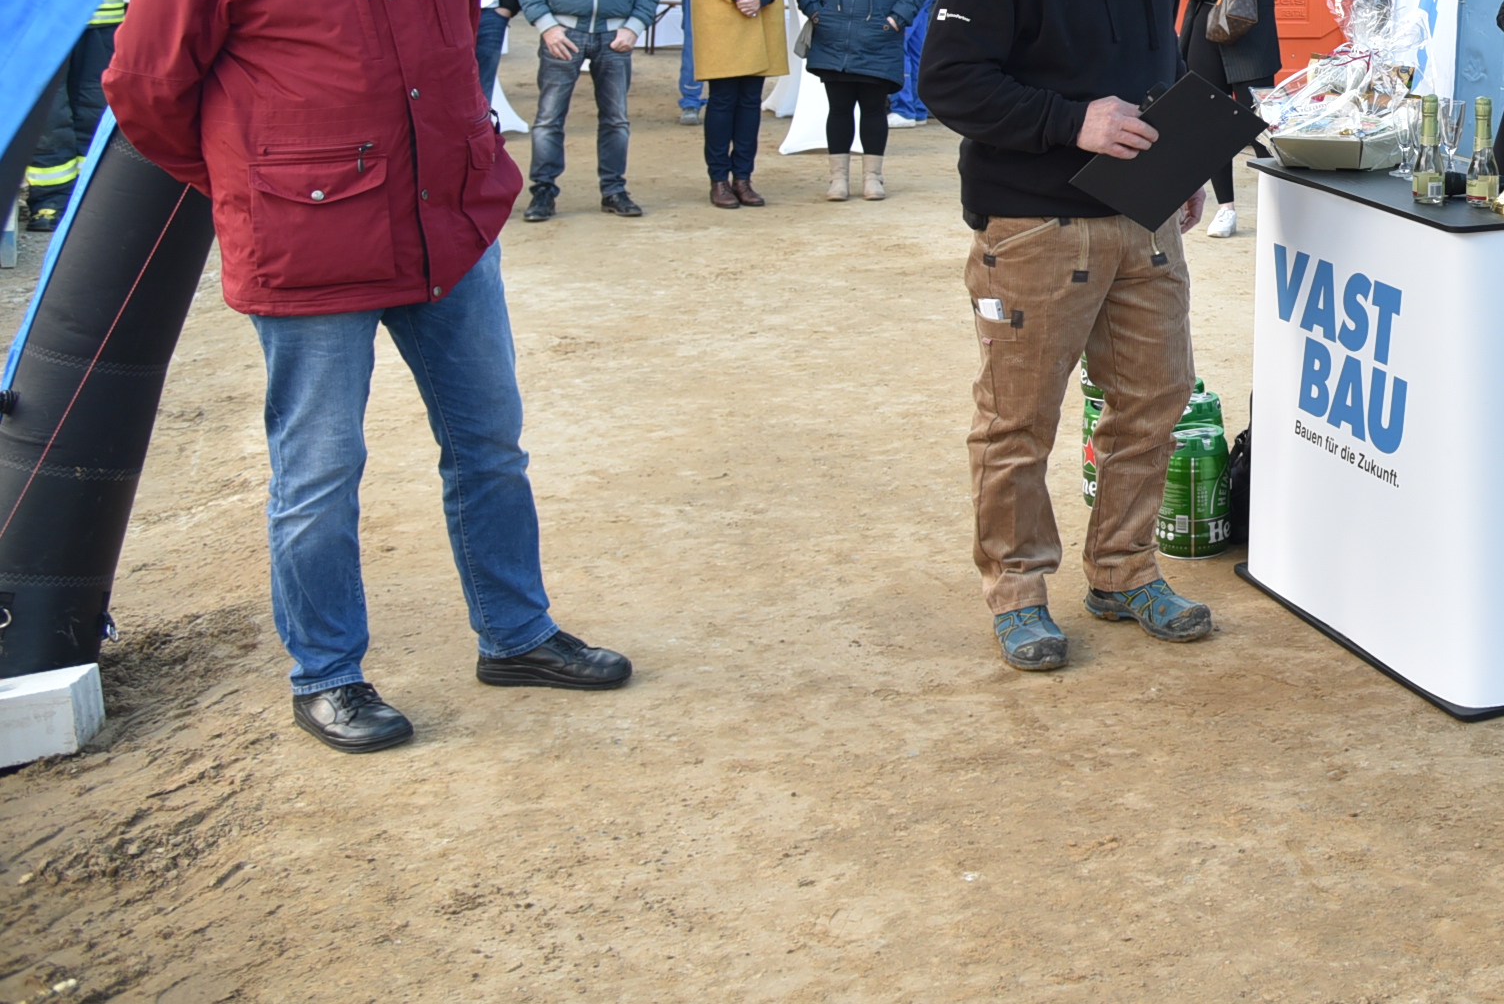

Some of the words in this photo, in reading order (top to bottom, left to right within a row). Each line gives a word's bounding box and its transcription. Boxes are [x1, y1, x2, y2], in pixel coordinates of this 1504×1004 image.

[1274, 243, 1402, 366] VAST
[1294, 419, 1323, 448] Bauen
[1325, 435, 1339, 456] für
[1340, 445, 1356, 465] die
[1357, 452, 1400, 489] Zukunft.
[1298, 336, 1408, 455] BAU
